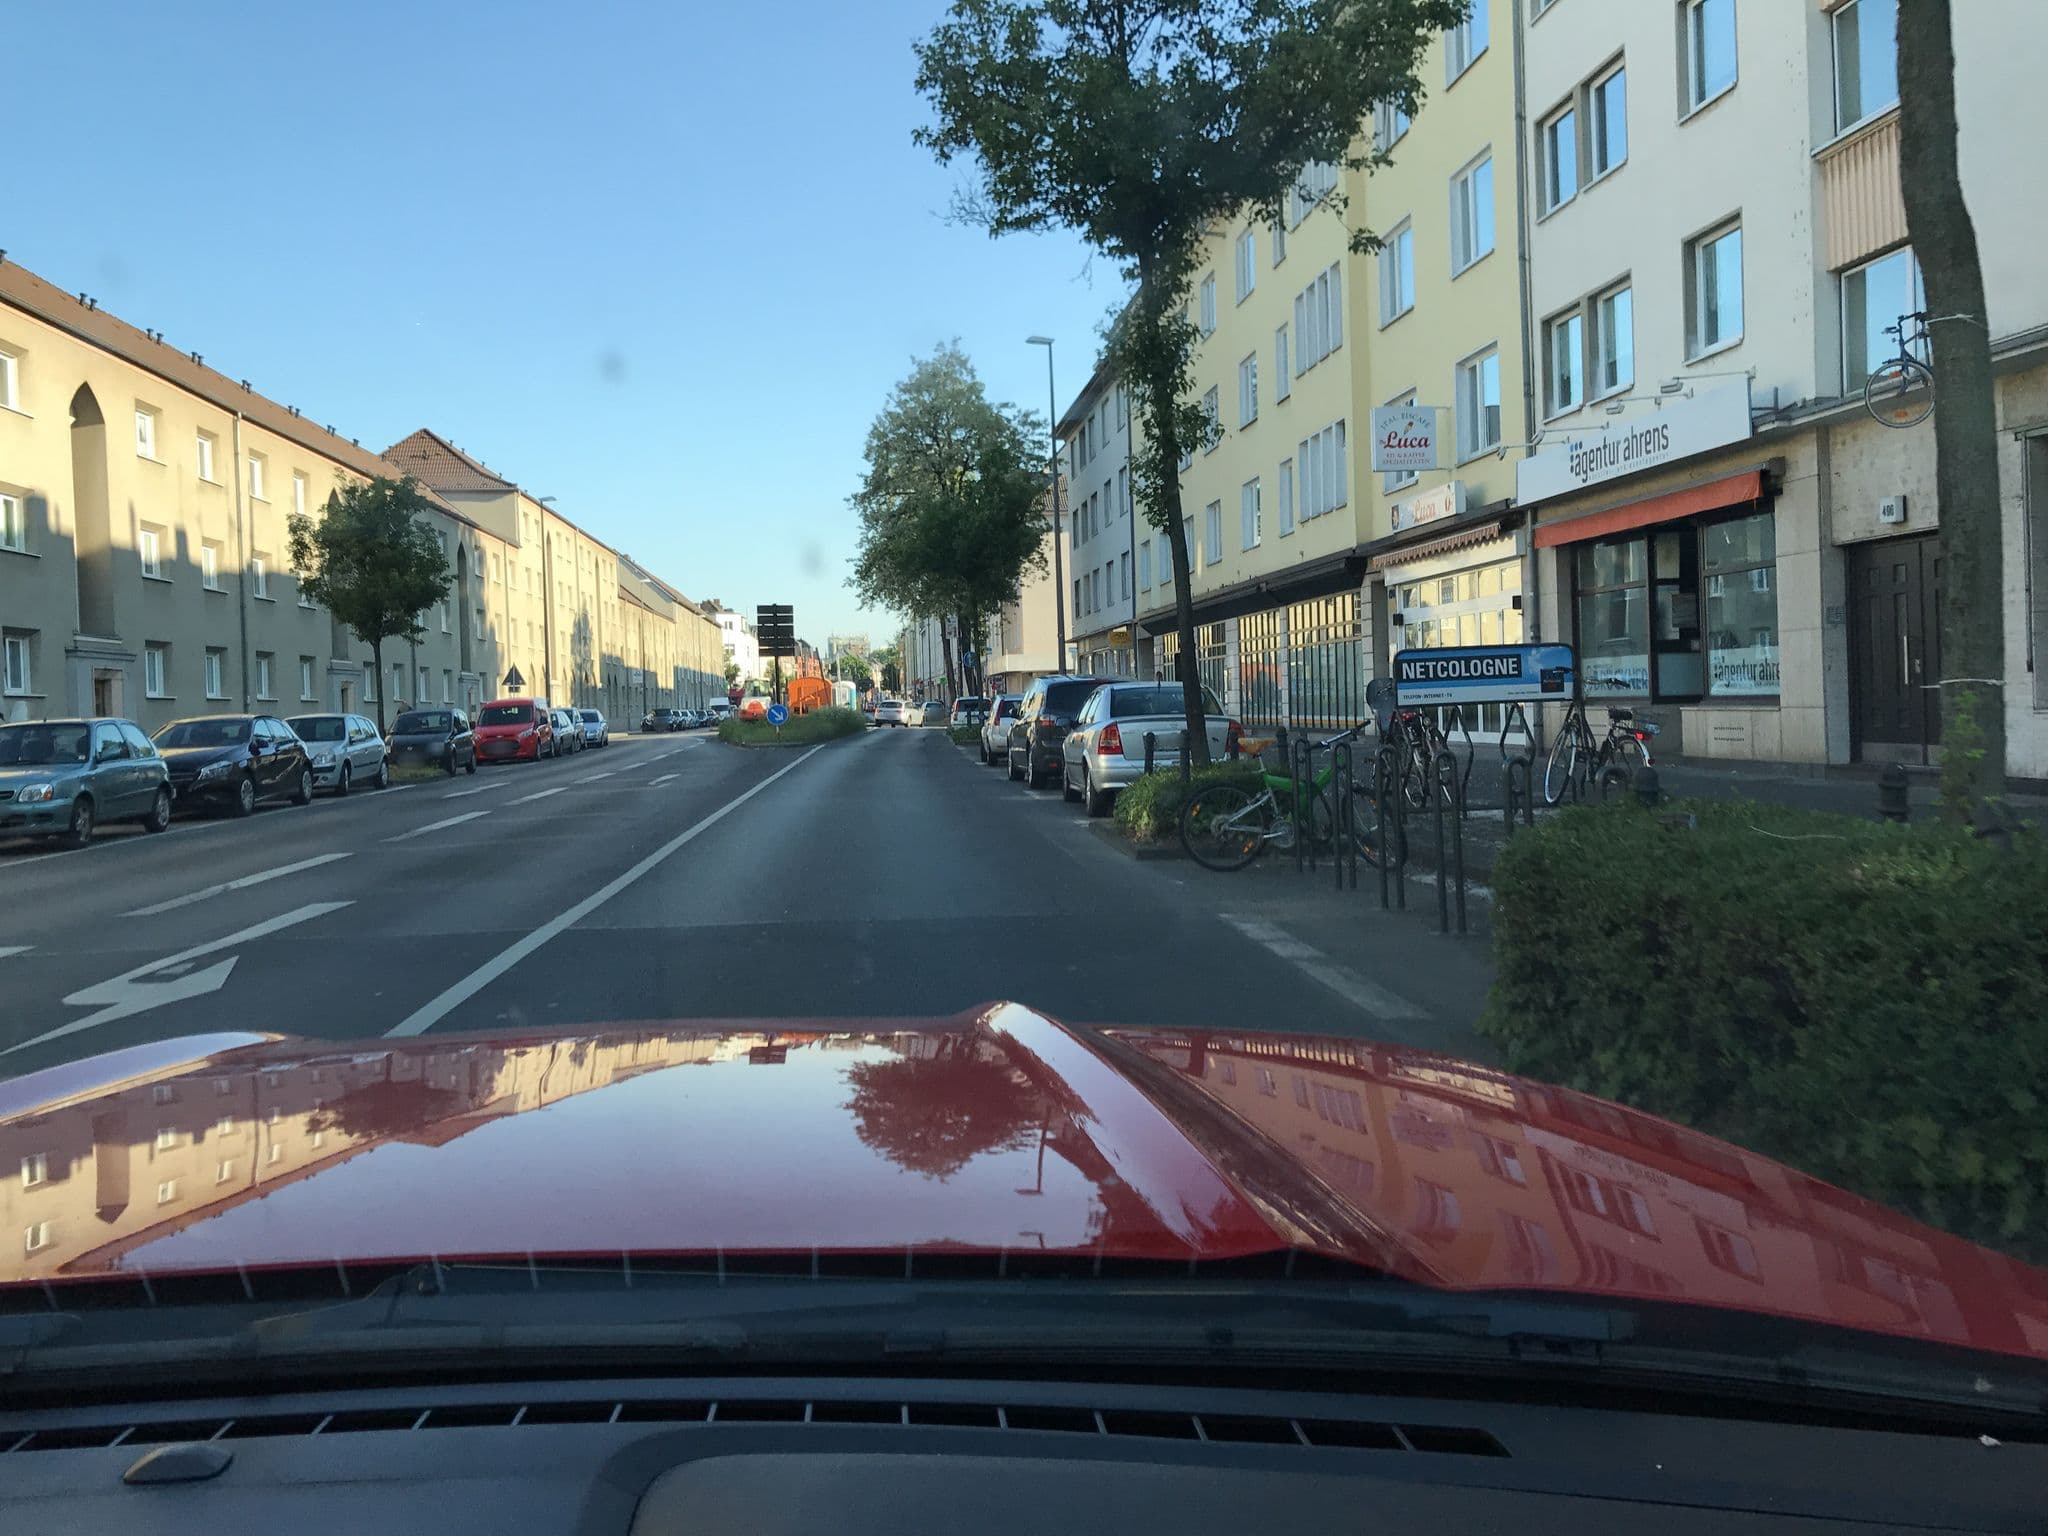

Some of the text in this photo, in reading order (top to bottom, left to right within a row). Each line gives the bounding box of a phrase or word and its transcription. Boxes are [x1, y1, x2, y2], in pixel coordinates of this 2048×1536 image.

[1384, 430, 1430, 449] Luca
[1623, 424, 1669, 462] ahrens
[1402, 657, 1519, 680] NETCOLOGNE
